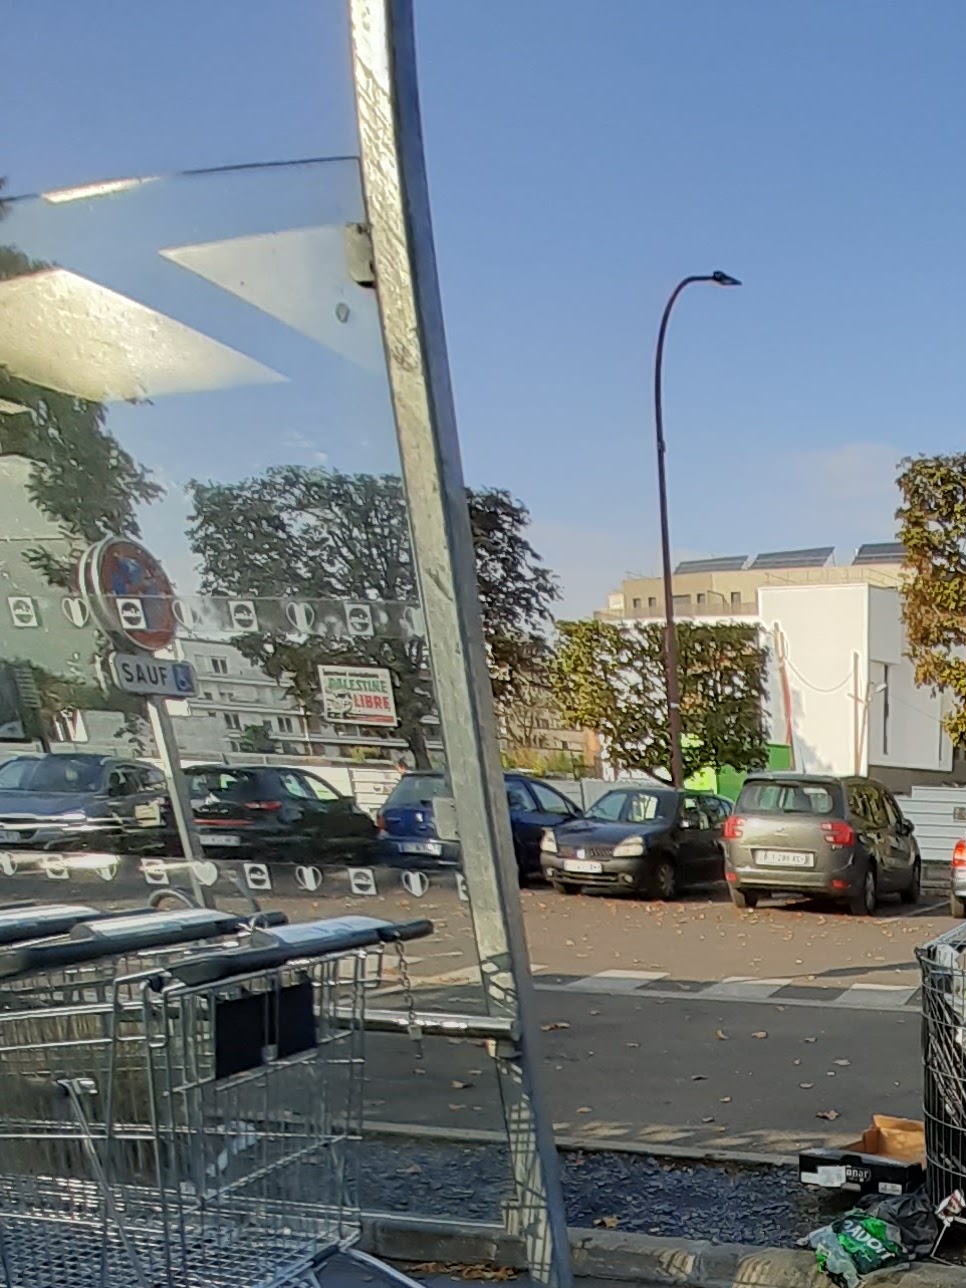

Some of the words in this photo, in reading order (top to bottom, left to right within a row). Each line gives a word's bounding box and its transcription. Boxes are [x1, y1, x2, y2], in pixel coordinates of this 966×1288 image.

[122, 662, 167, 686] SAUF
[328, 677, 388, 693] PALESTINE
[353, 693, 390, 709] LIBRE
